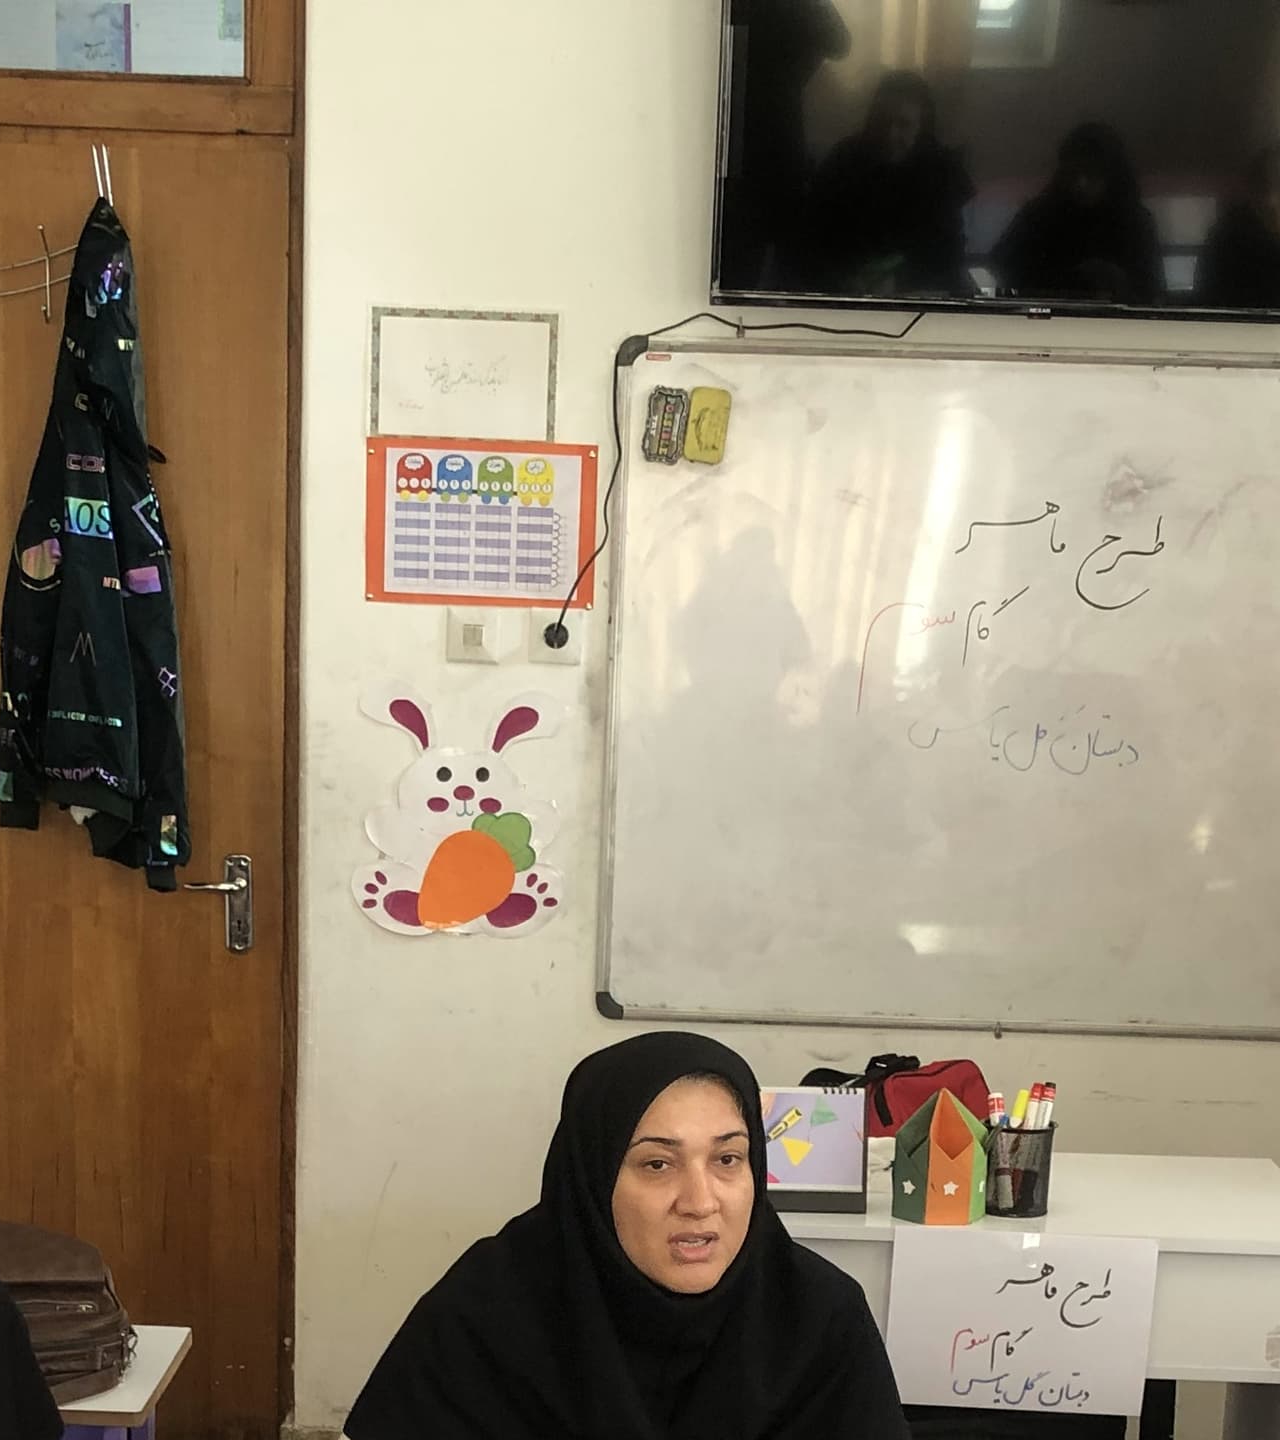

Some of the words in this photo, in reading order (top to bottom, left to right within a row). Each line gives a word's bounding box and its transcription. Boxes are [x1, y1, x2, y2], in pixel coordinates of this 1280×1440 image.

[954, 501, 1066, 554] ماهر
[1075, 514, 1166, 611] طرح
[962, 585, 1030, 668] گام
[855, 601, 956, 717] سوم
[995, 1263, 1057, 1299] ماهر
[1060, 1268, 1111, 1328] طرح
[951, 1328, 990, 1374] سوم
[990, 1326, 1033, 1371] گام
[952, 1373, 1010, 1403] یاس
[1003, 1371, 1051, 1405] گل
[1038, 1372, 1090, 1407] دبستان
